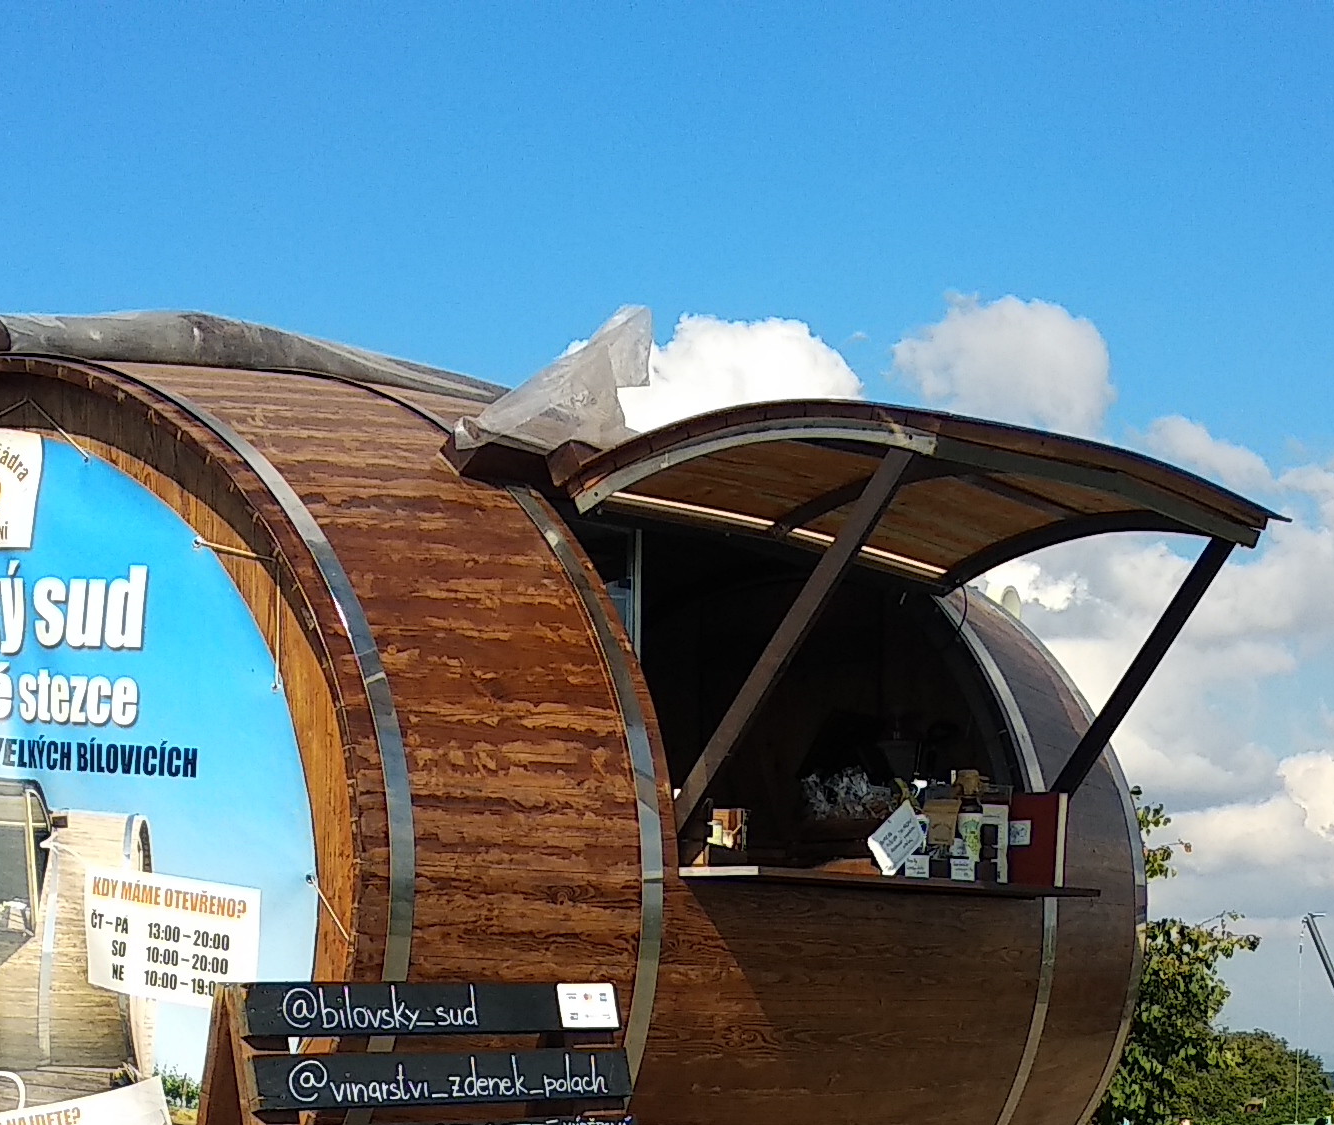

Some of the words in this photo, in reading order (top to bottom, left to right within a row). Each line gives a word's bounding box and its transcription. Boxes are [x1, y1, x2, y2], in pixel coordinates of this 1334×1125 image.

[34, 563, 149, 651] sud
[19, 668, 139, 726] stezce
[77, 737, 198, 778] BÍLOVICÍCH
[92, 875, 119, 899] KDY
[121, 880, 161, 906] MÁME
[164, 888, 247, 919] OTEVŘENO?
[90, 909, 104, 929] ČT
[114, 915, 129, 934] PÁ
[147, 922, 181, 943] 13:00
[193, 930, 230, 951] 20:00
[111, 939, 127, 958] SO
[145, 946, 179, 966] 10:00
[191, 953, 229, 975] 20:00
[111, 963, 125, 981] NE
[143, 969, 178, 990] 10:00
[191, 978, 217, 997] 19:0
[282, 984, 479, 1030] @bilovsky_sud
[288, 1053, 610, 1104] @vinarstvi_zdenek_polach
